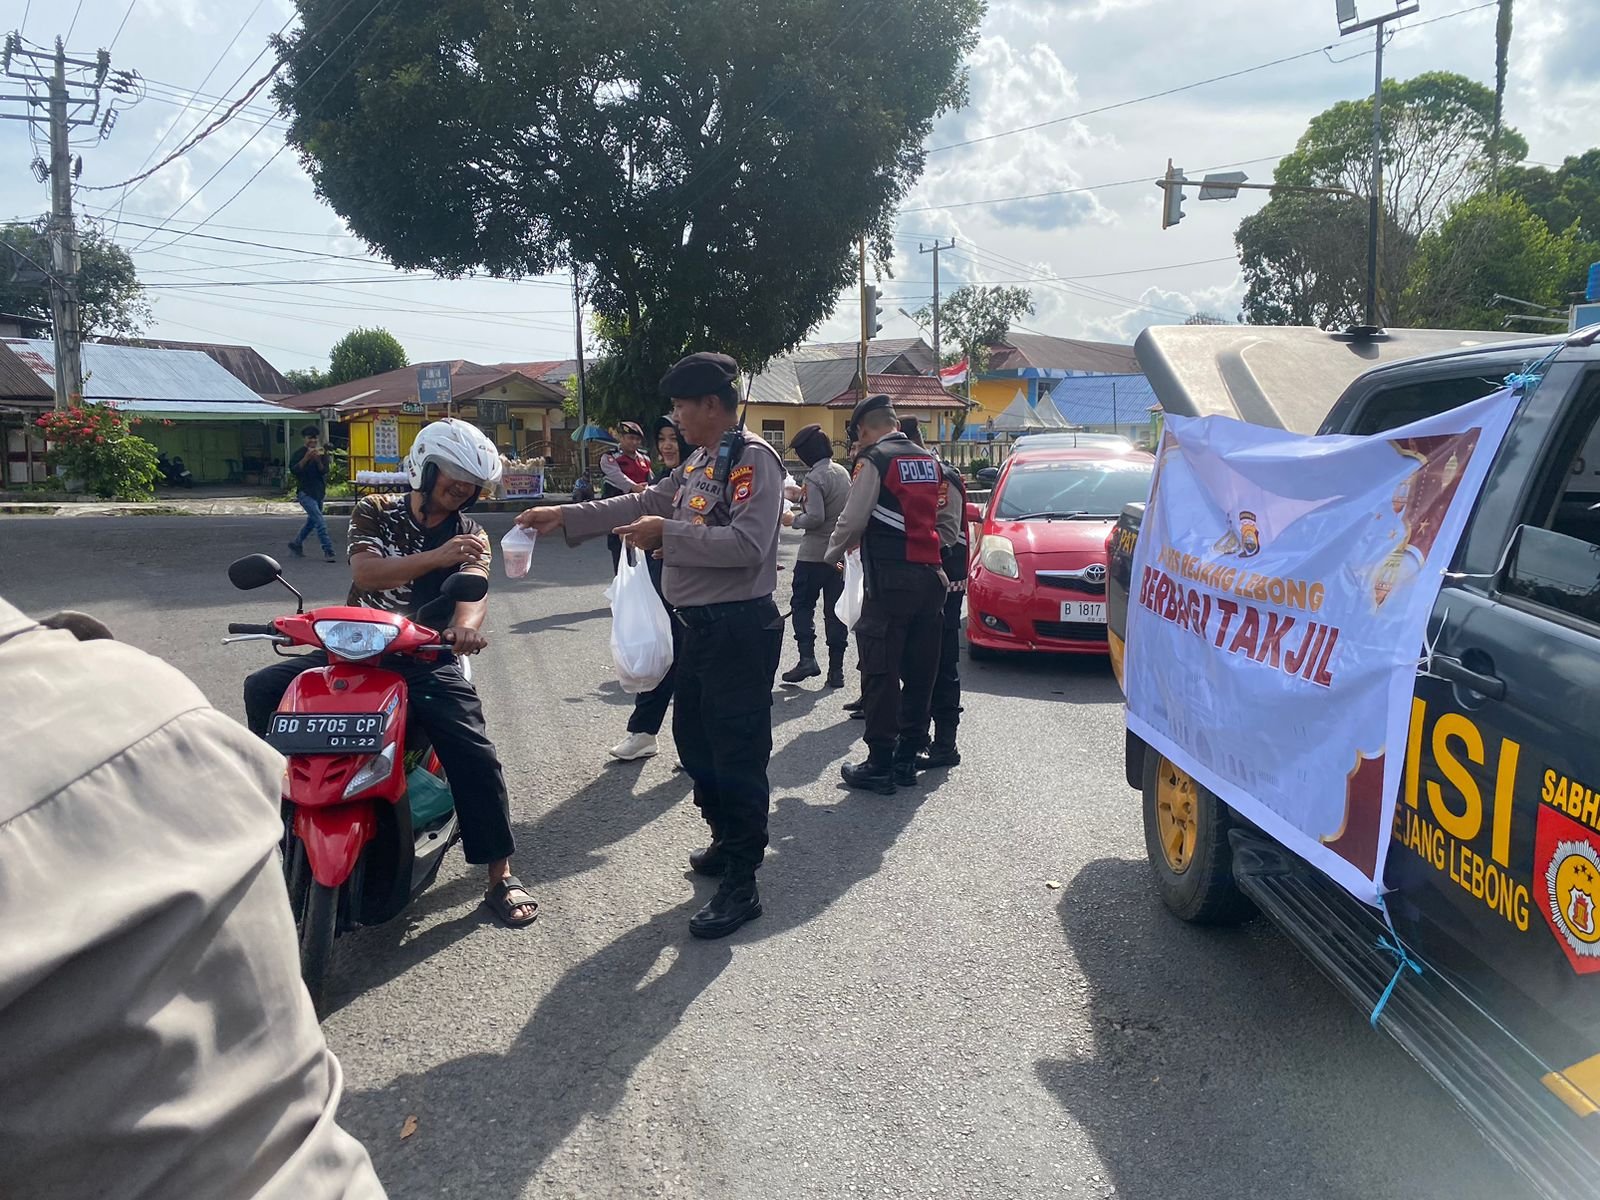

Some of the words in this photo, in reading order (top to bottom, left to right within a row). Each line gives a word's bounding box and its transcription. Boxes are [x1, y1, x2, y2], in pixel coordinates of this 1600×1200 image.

[1121, 529, 1137, 555] PAT
[1065, 603, 1071, 615] B
[1079, 603, 1101, 616] 1817
[1234, 571, 1325, 612] LEBONG
[1139, 564, 1212, 640] BERBAGI
[1214, 597, 1340, 688] TAKJIL
[278, 719, 299, 733] BD
[306, 719, 348, 733] 5705
[356, 719, 376, 733] CP
[1404, 696, 1520, 868] ISI
[1541, 768, 1600, 830] SABH
[1392, 803, 1445, 870] EJANG
[1450, 838, 1530, 932] LEBONG
